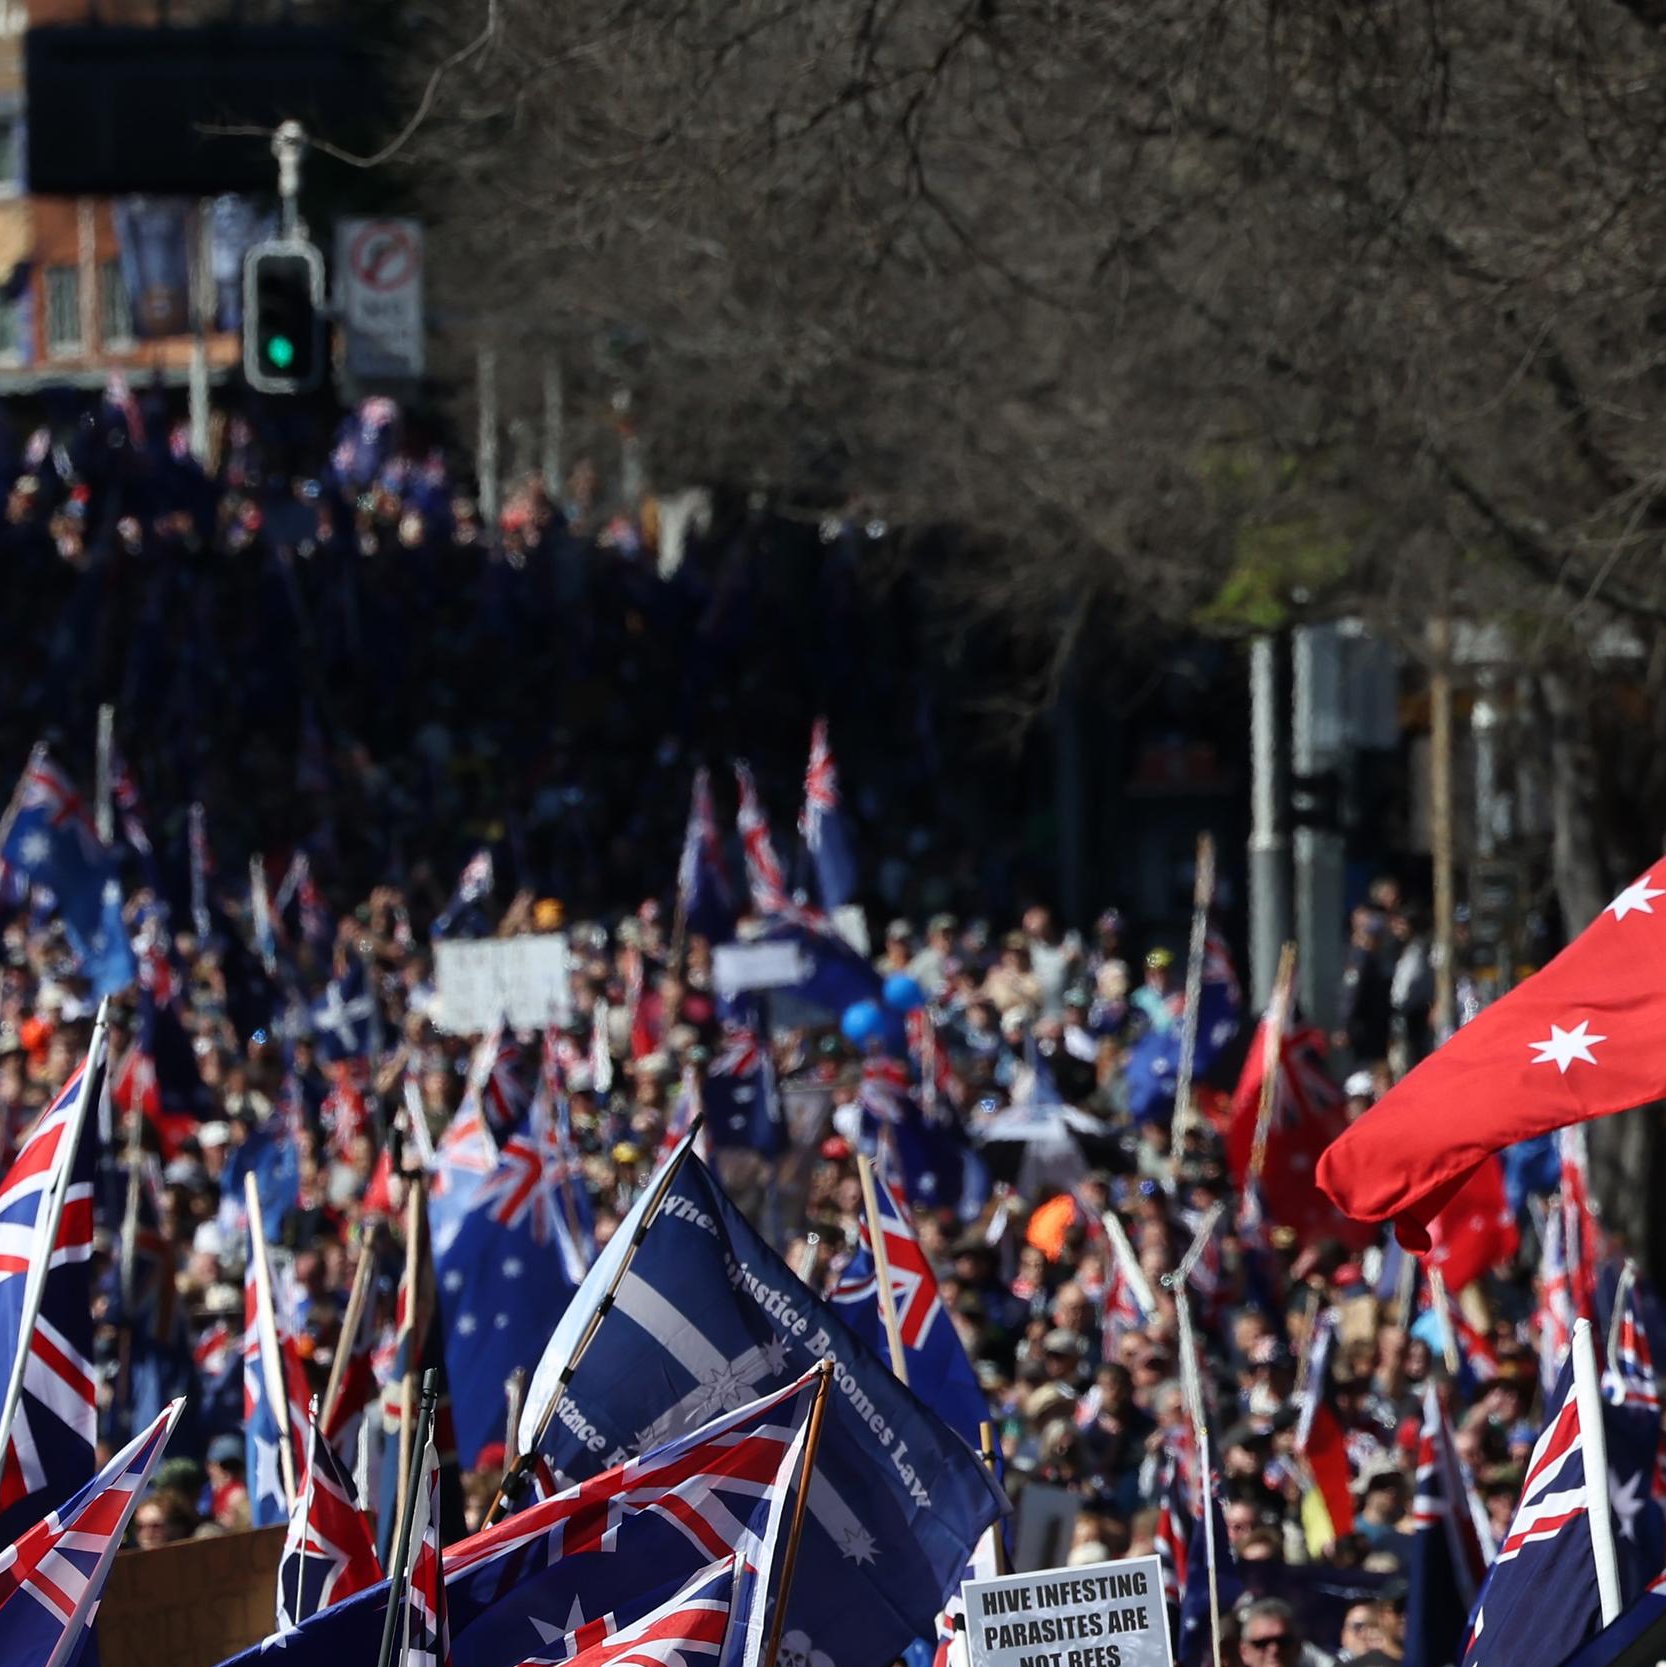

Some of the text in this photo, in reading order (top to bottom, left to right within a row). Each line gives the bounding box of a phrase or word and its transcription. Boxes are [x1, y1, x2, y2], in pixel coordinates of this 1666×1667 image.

[890, 1440, 931, 1507] Law
[982, 1572, 1148, 1616] HIVE INFESTING
[985, 1606, 1149, 1650] PARASITES ARE
